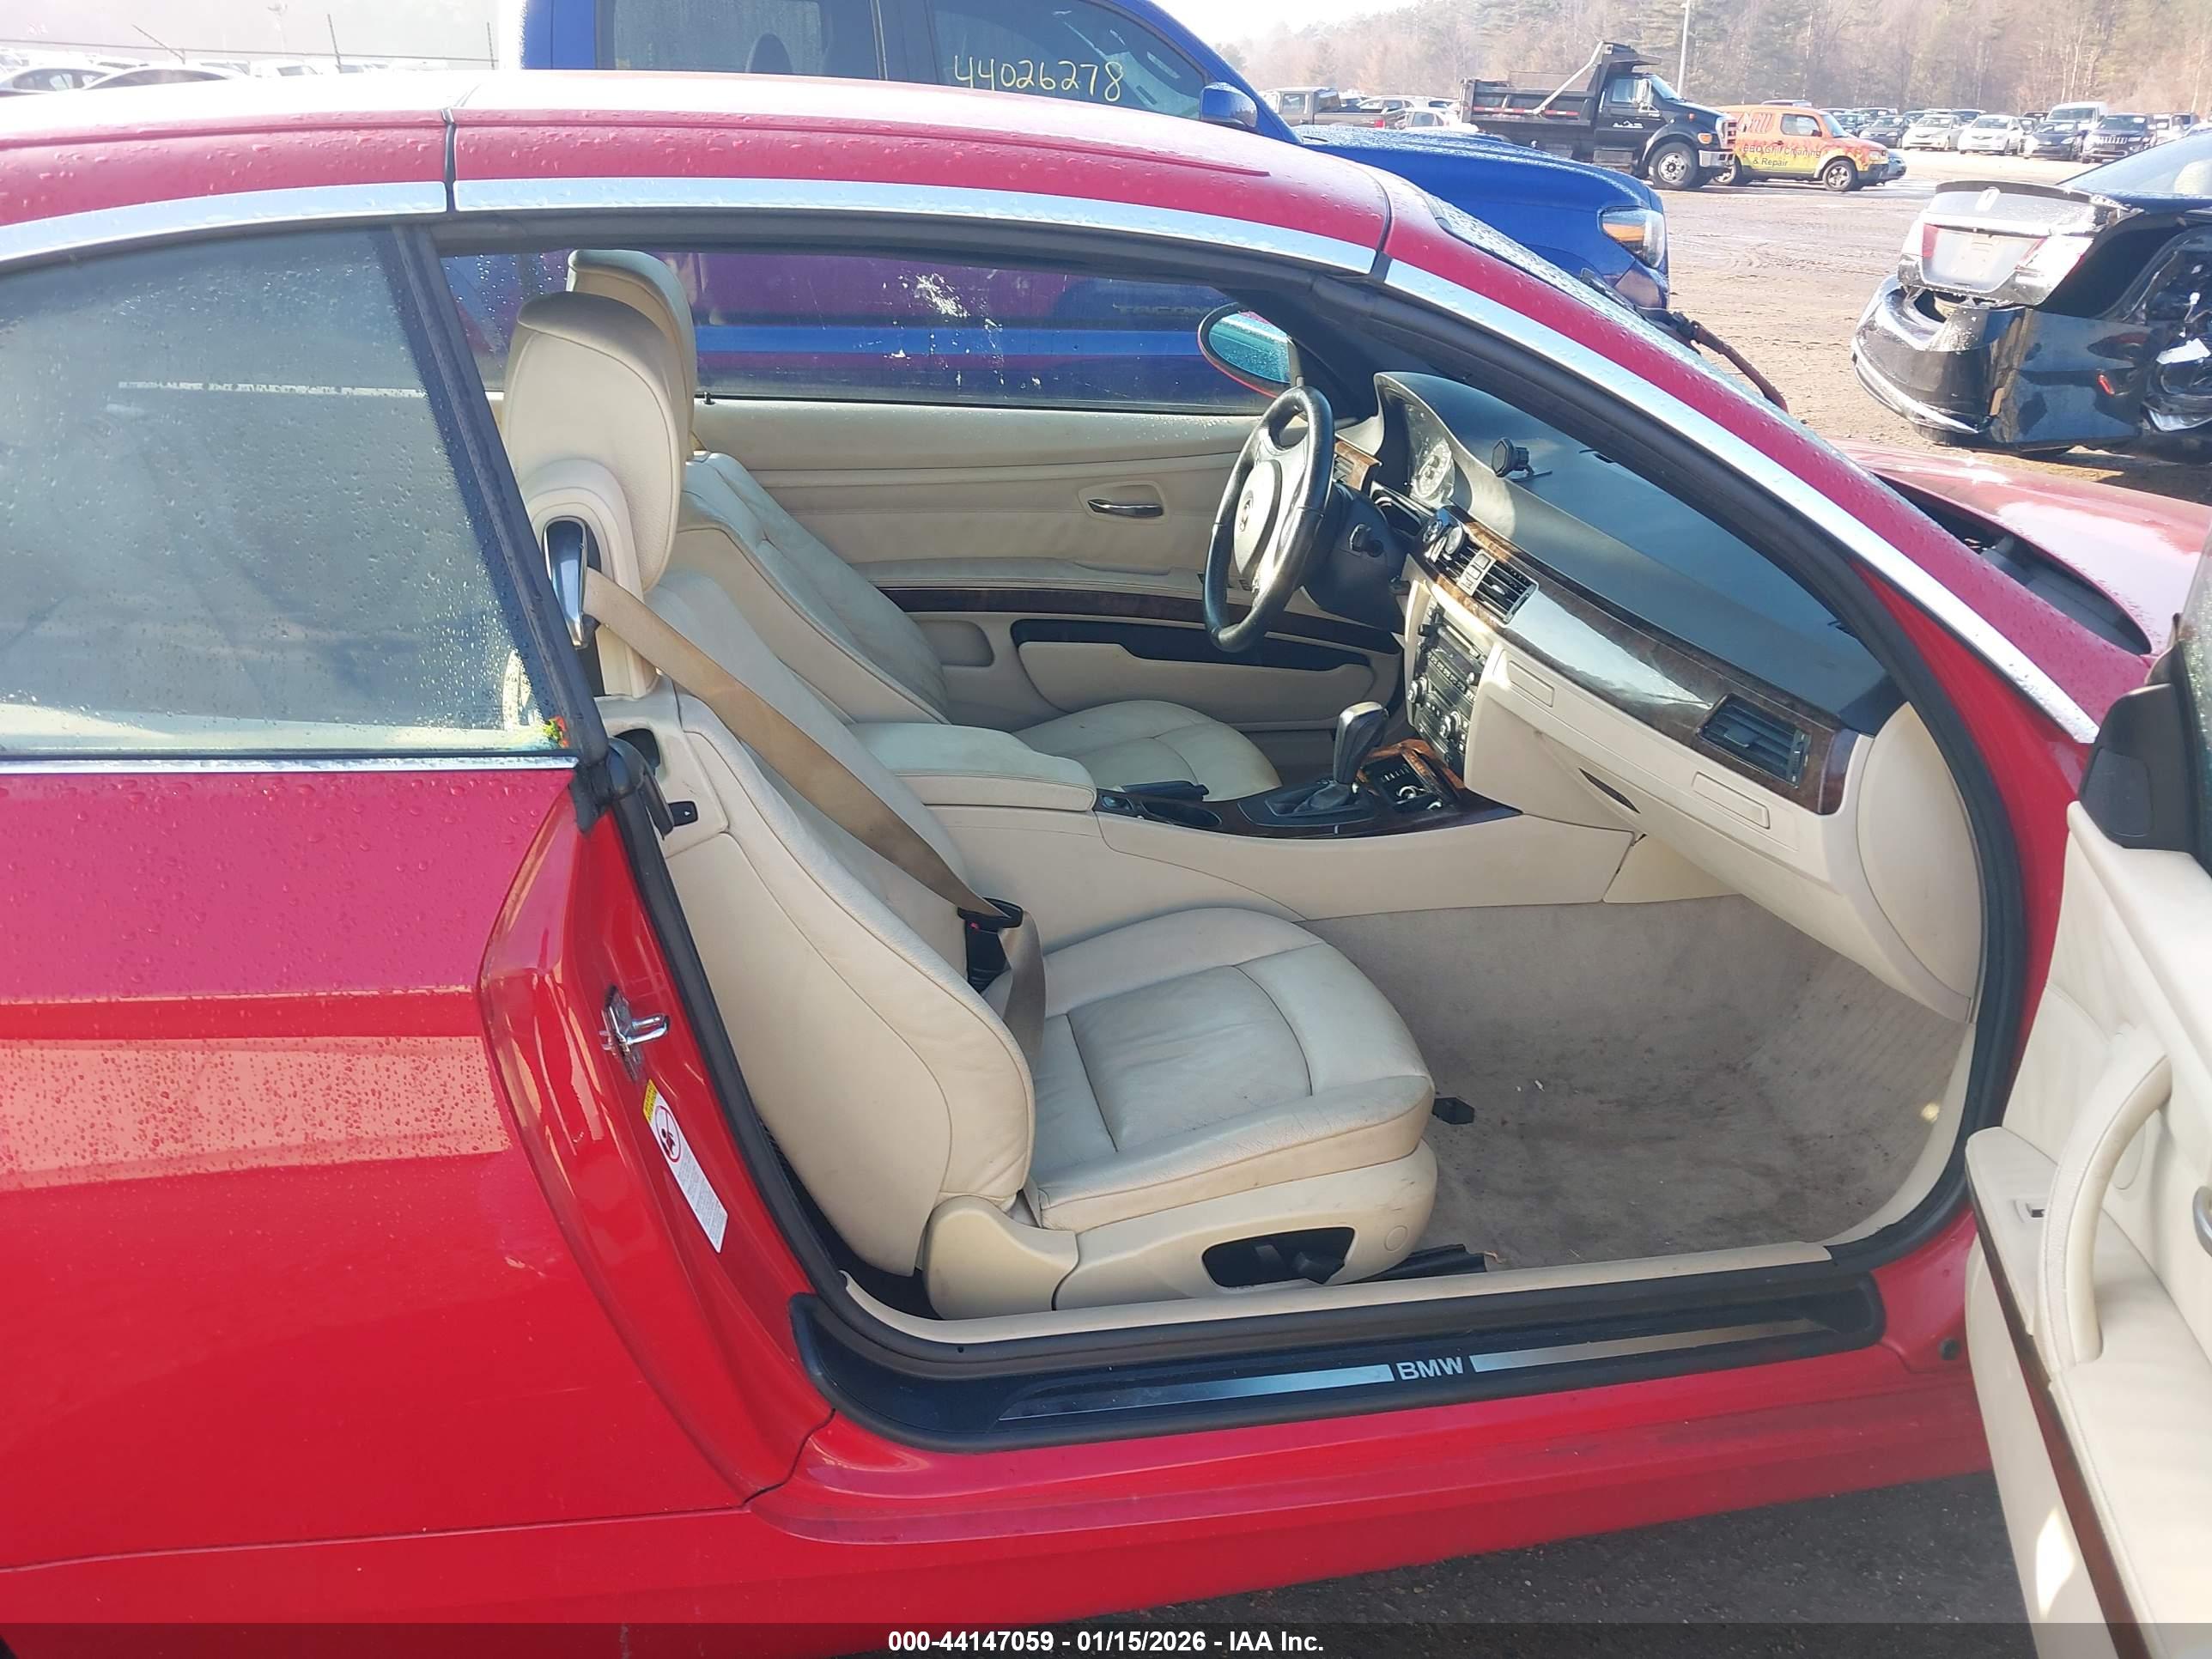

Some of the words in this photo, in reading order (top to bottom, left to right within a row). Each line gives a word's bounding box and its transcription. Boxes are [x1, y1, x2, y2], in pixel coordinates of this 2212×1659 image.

[954, 55, 1125, 102] 44026278
[1784, 147, 1821, 158] Cleaning
[1761, 157, 1788, 167] Repair
[1396, 1357, 1464, 1380] BMW
